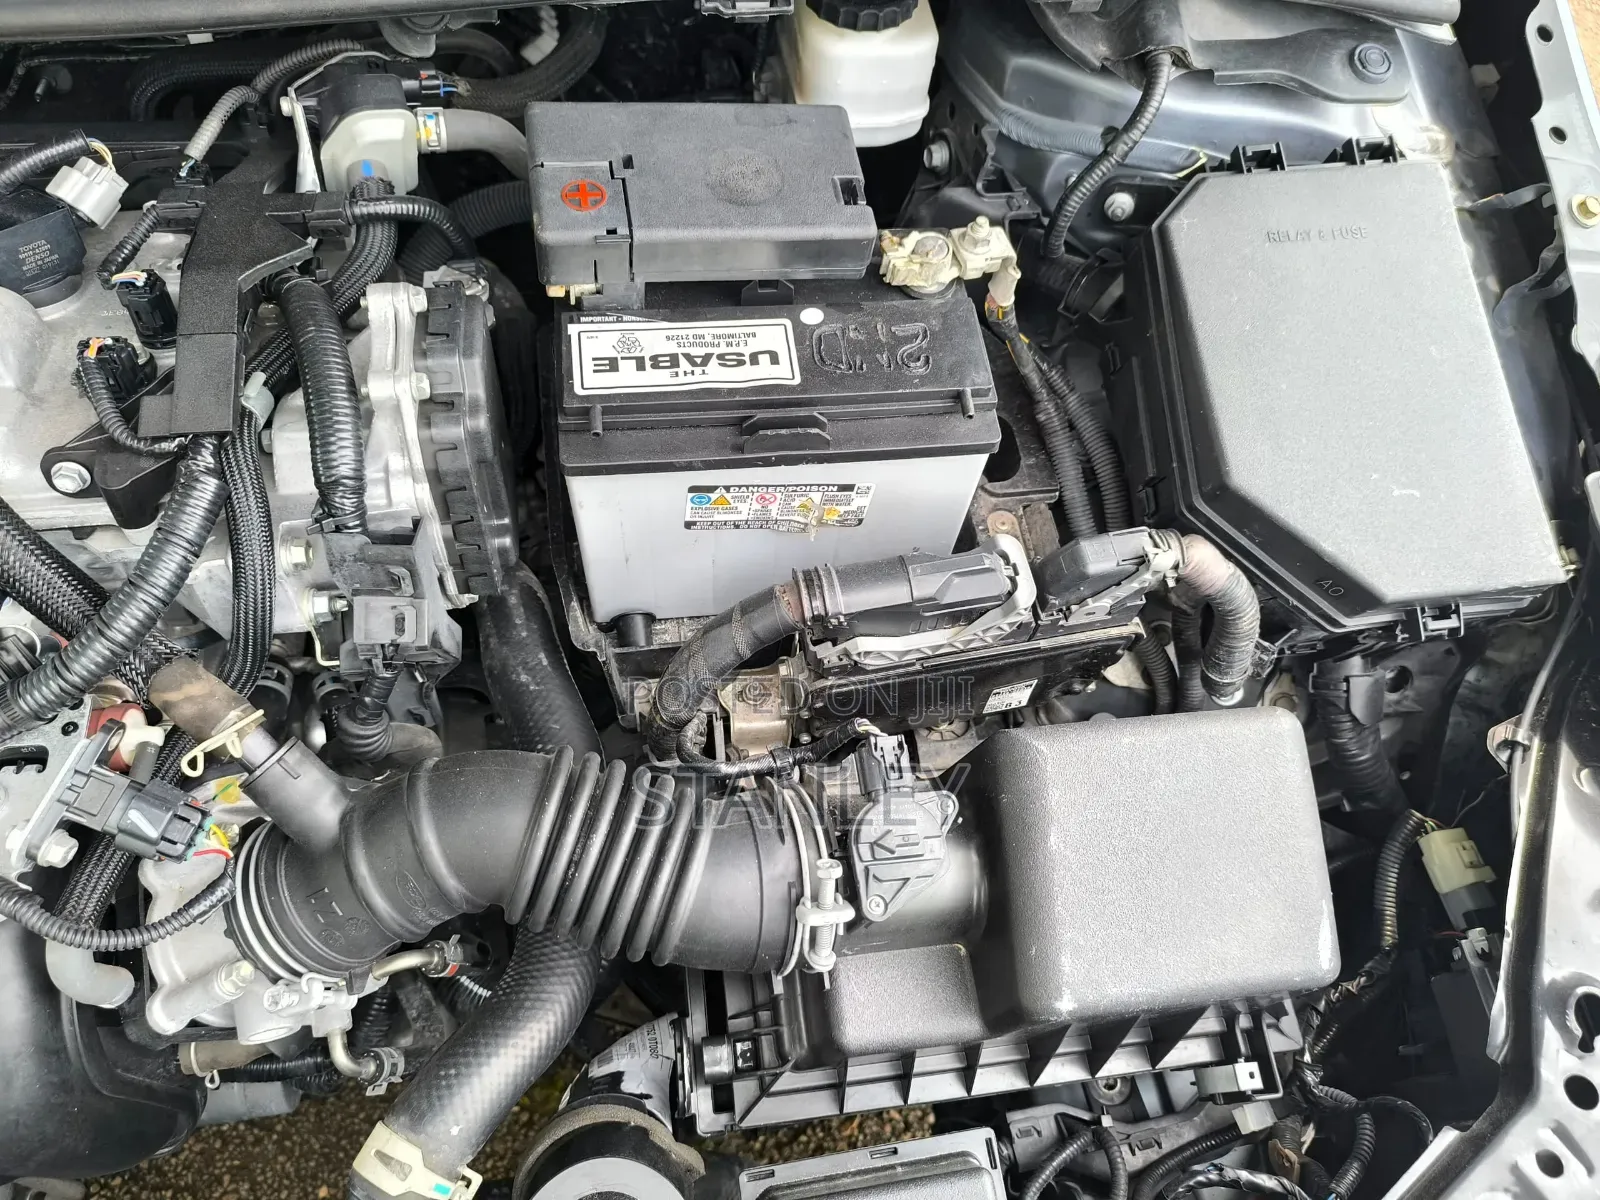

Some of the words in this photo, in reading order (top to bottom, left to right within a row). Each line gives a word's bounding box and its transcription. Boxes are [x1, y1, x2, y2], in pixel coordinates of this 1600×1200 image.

[1265, 229, 1311, 243] RELAY
[1331, 225, 1368, 240] FUSE
[19, 240, 47, 253] TOYOTA
[25, 250, 50, 264] DENSO
[708, 332, 757, 340] BALTIMORE,
[677, 340, 721, 348] PRODUCTS
[592, 349, 780, 374] USABLE
[669, 369, 709, 378] THE
